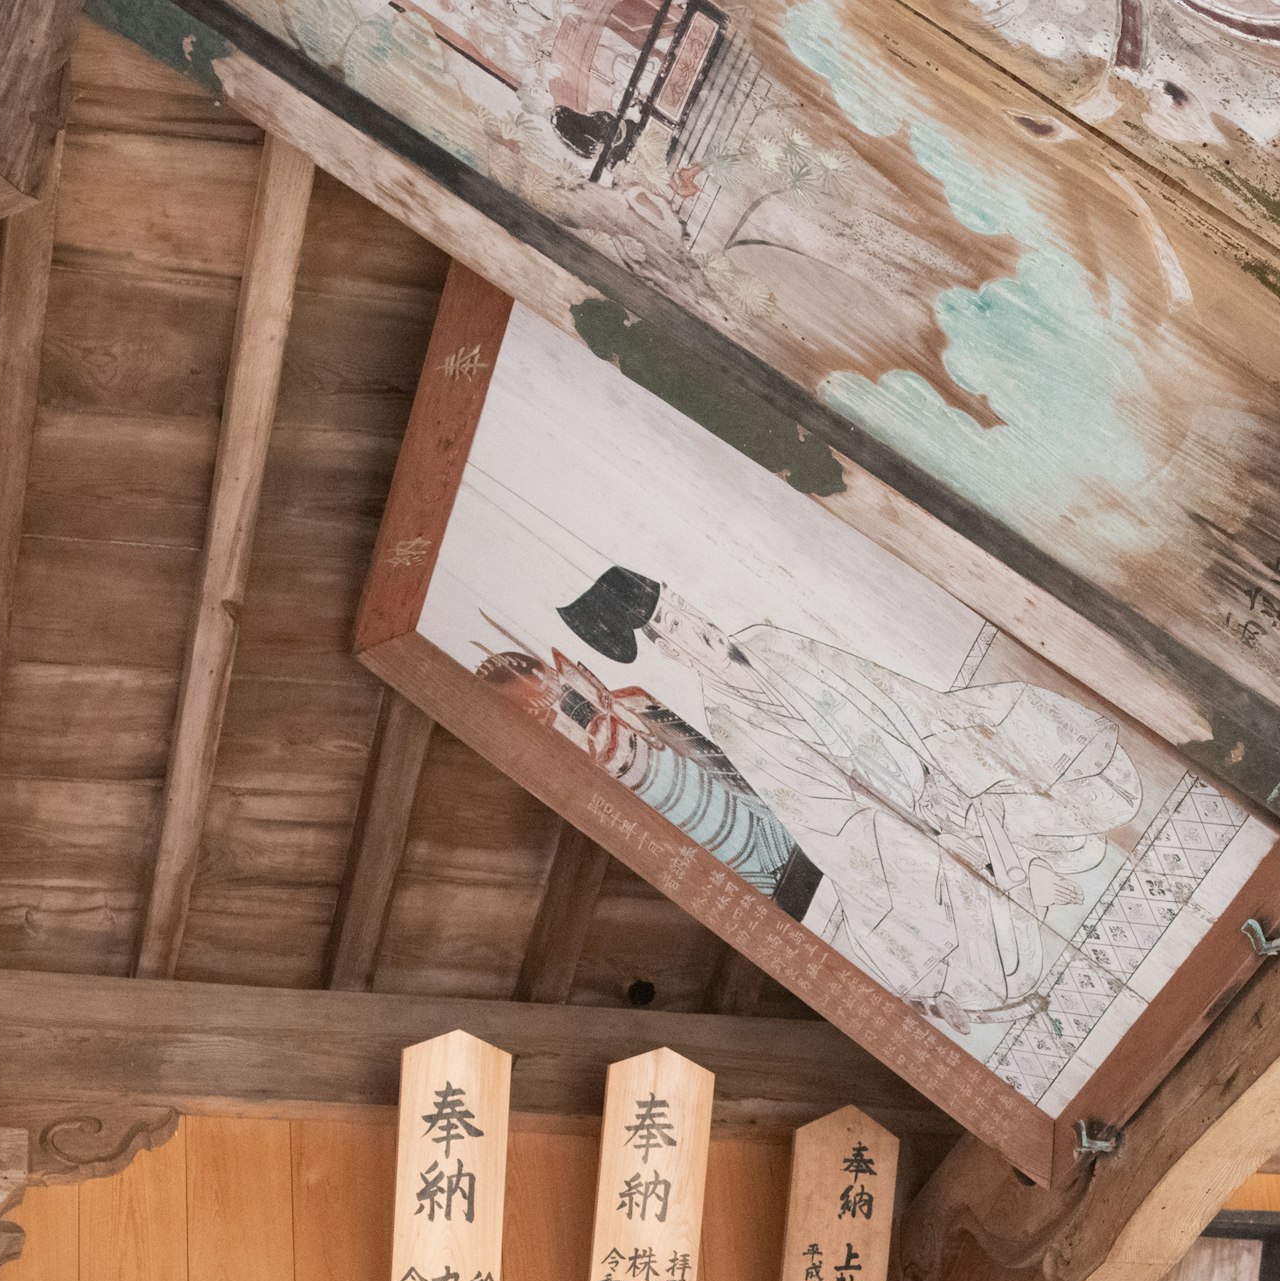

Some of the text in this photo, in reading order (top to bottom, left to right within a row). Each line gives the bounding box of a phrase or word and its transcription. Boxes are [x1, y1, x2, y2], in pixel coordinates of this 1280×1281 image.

[413, 1081, 485, 1224] 奉納
[616, 1092, 677, 1224] 奉納
[837, 1141, 878, 1220] 奉納
